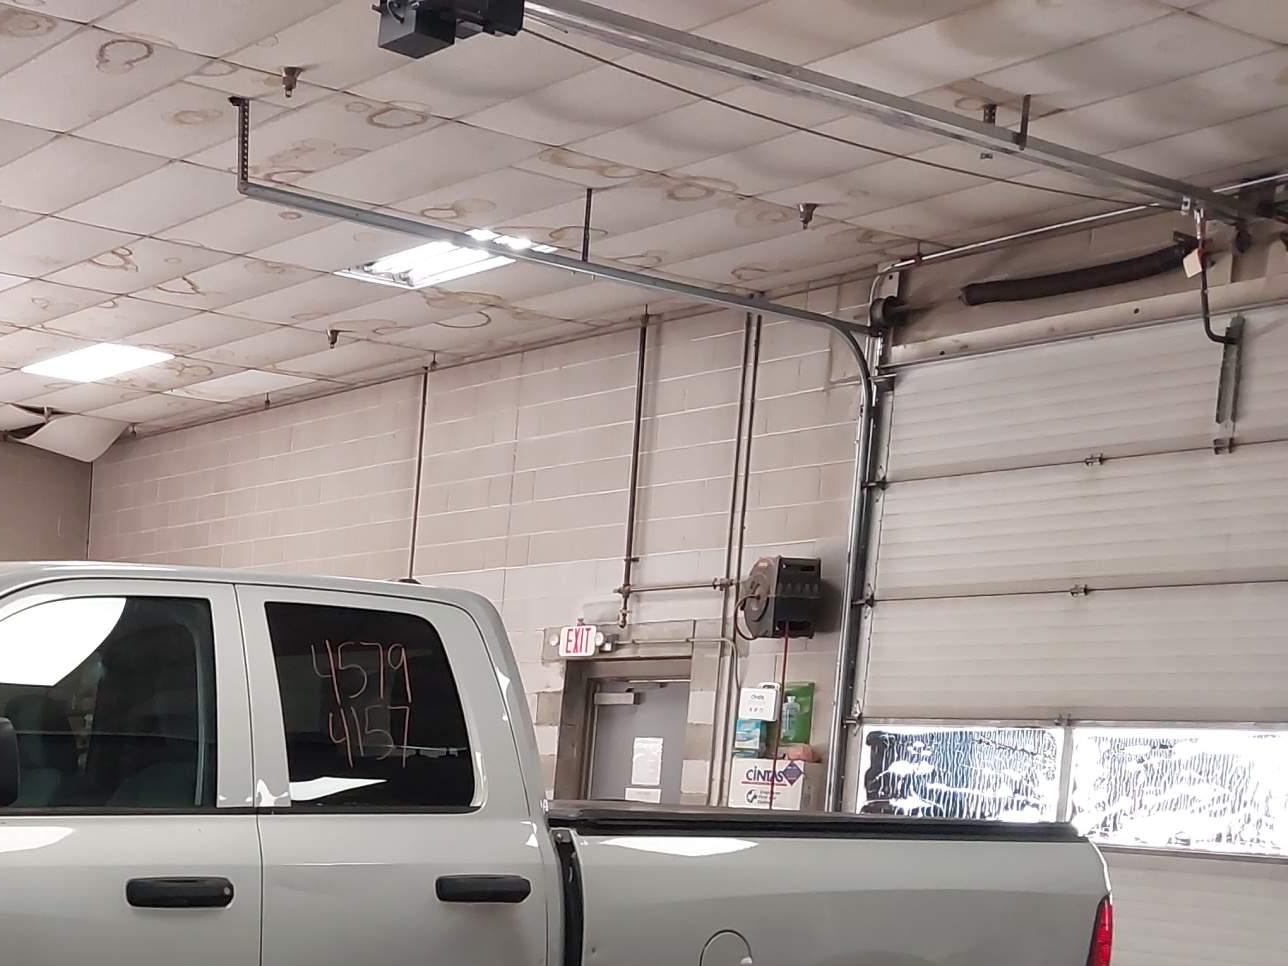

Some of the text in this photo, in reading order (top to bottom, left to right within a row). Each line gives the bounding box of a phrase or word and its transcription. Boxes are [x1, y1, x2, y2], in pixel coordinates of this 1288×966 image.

[565, 627, 592, 654] EXIT
[311, 640, 412, 705] 4579
[328, 705, 411, 768] 4157
